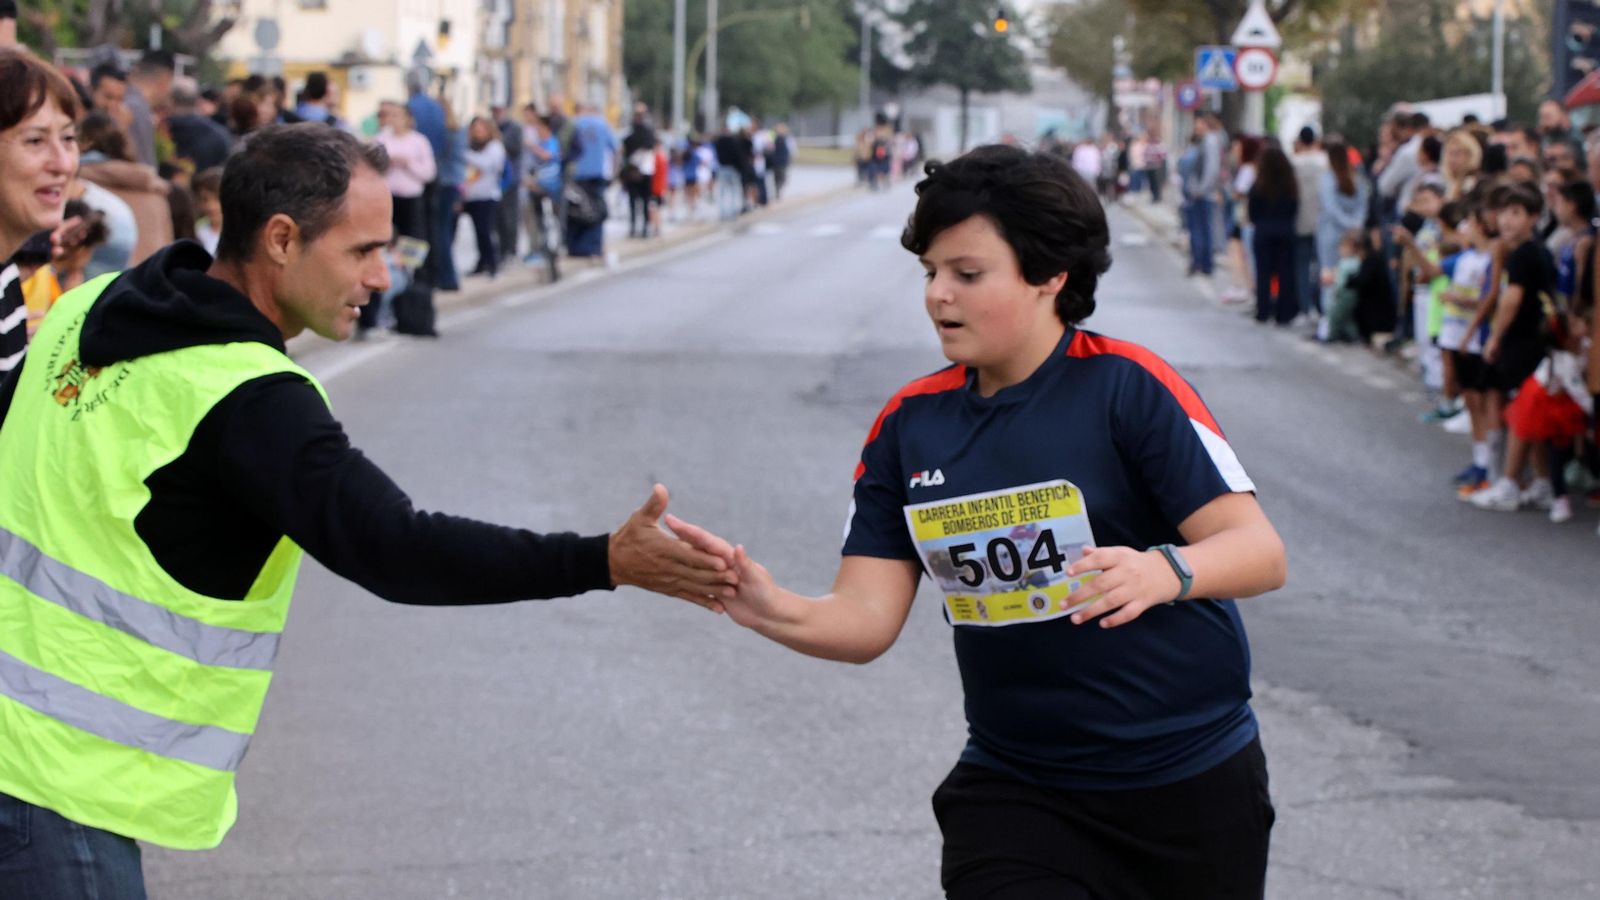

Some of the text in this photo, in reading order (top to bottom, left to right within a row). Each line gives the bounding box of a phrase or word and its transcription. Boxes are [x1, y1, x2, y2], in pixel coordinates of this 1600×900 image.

[909, 468, 945, 489] FILA
[917, 484, 1071, 523] CARRERA INFANTIL BENEFICA
[942, 504, 1051, 535] BOMBEROS DE JEREZ
[948, 528, 1067, 588] 504
